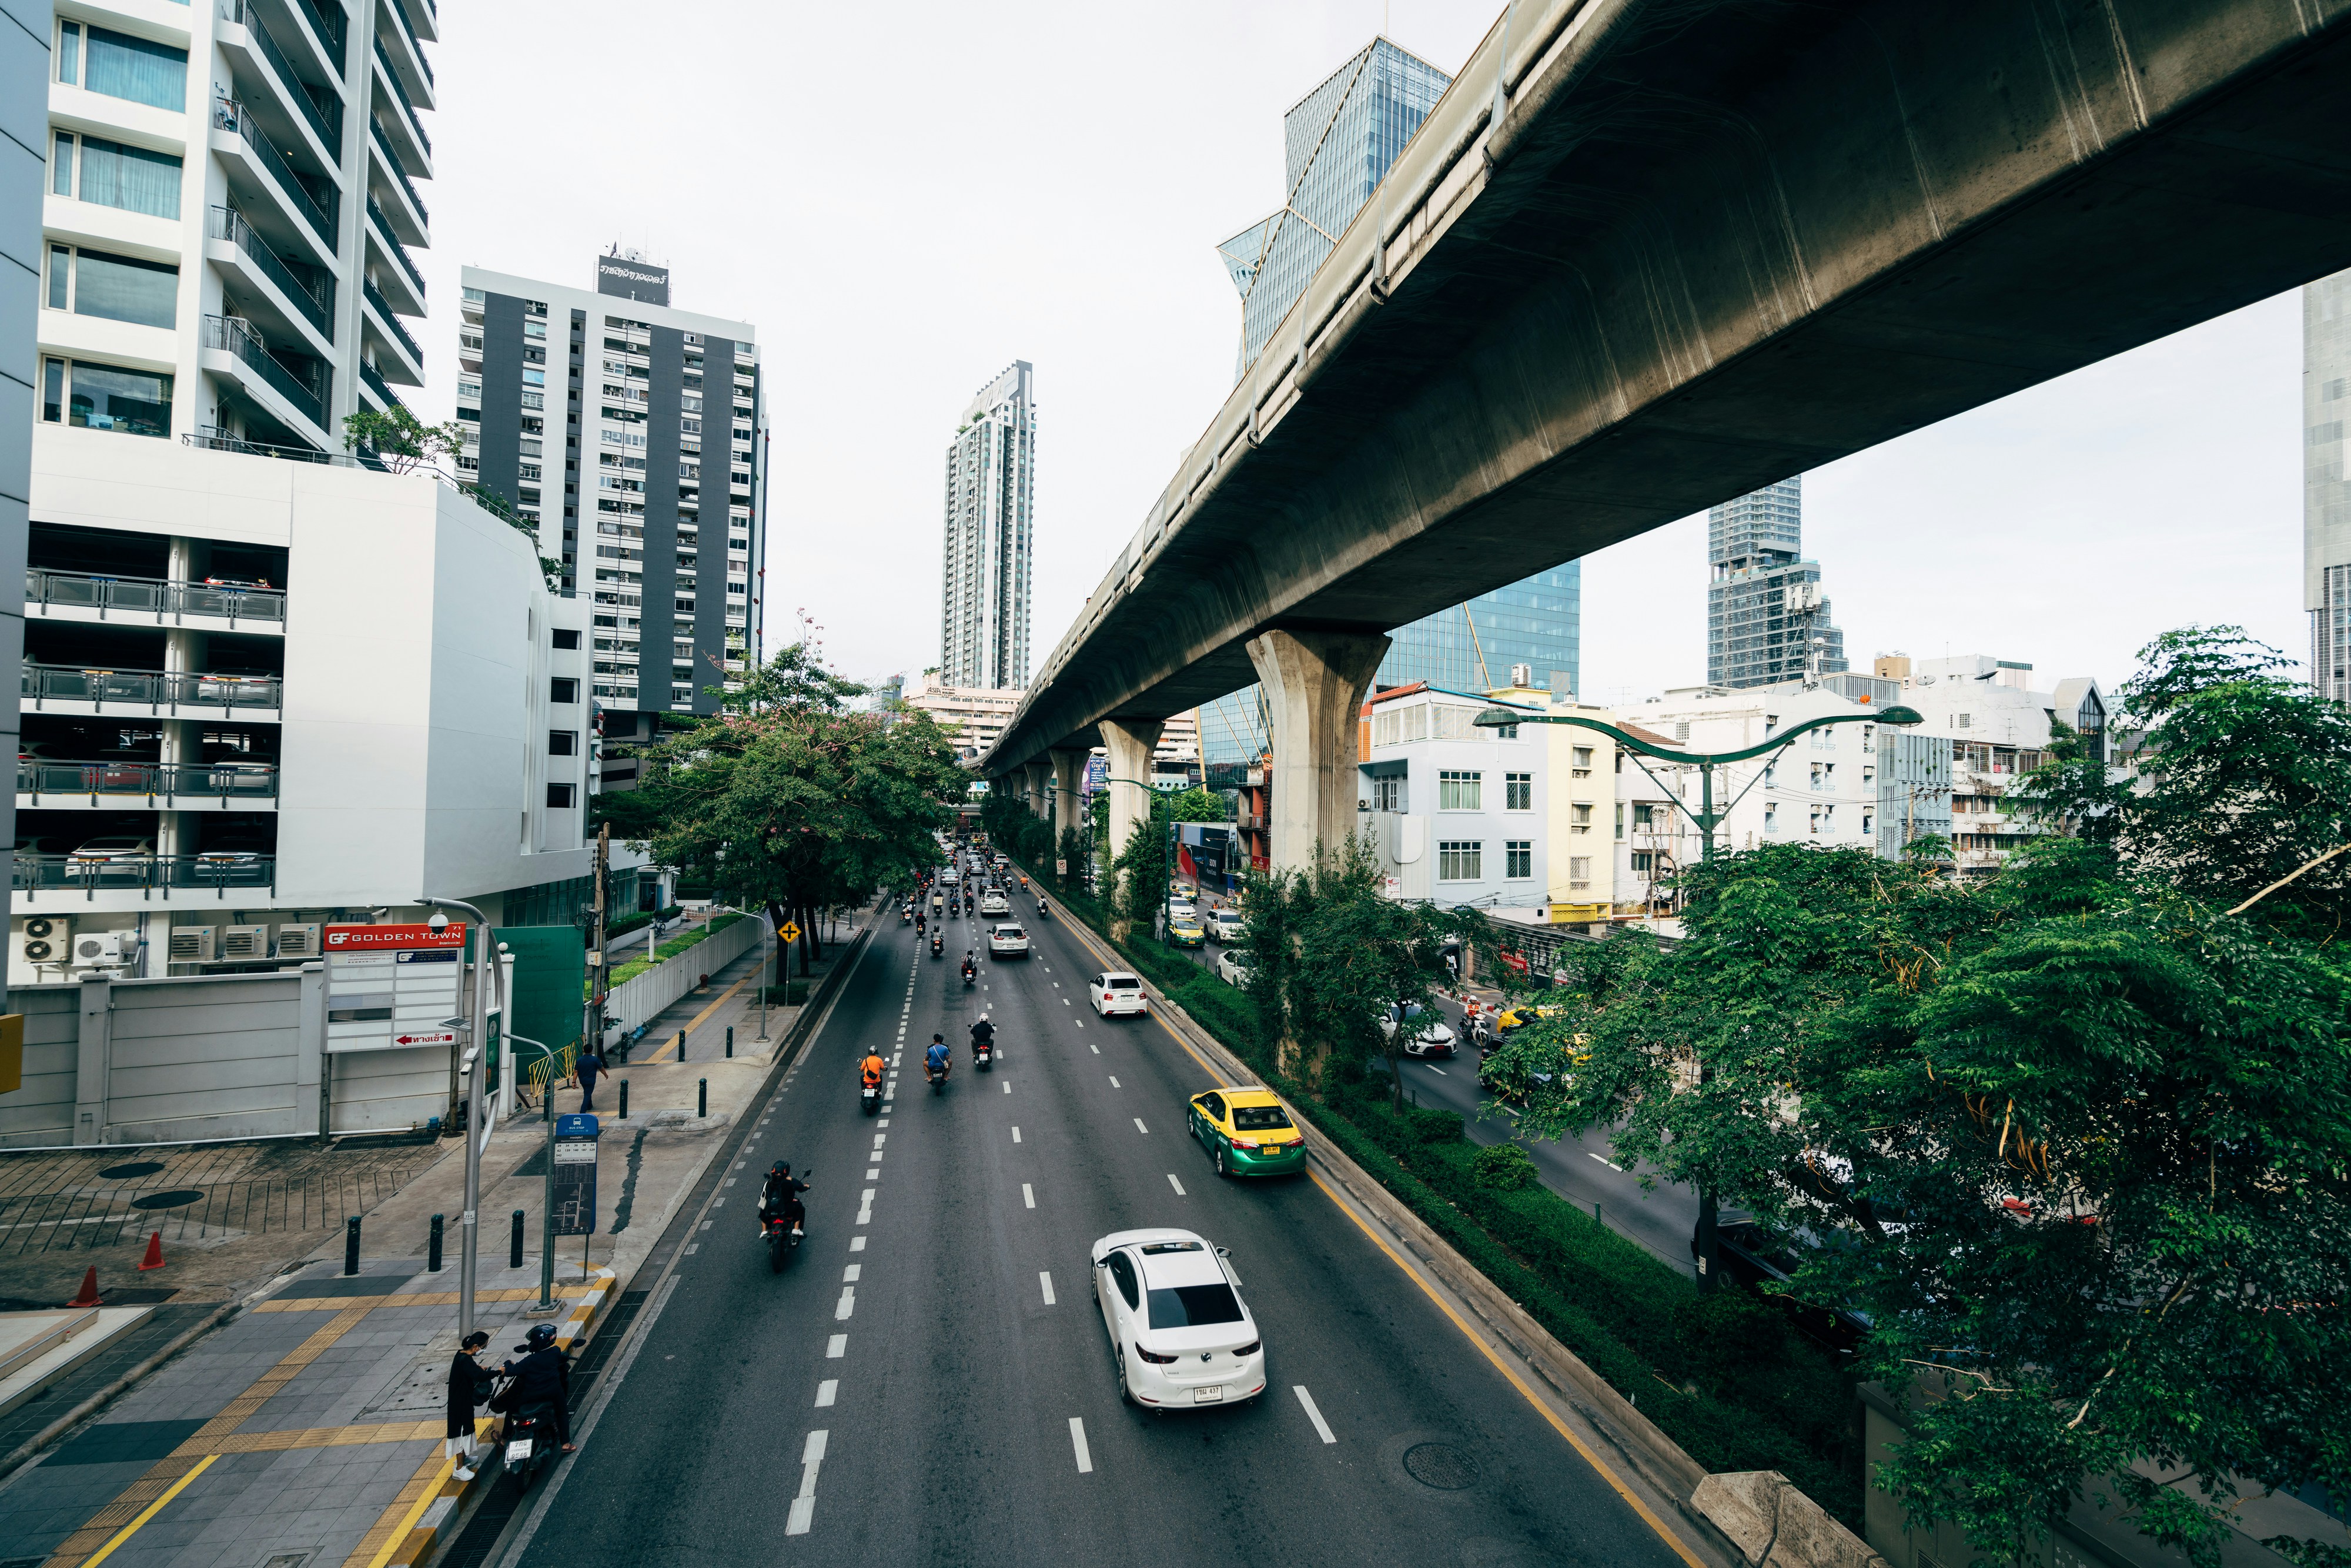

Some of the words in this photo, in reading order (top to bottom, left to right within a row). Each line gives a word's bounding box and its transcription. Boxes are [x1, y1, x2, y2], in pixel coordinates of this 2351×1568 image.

[352, 933, 414, 941] GOLDEN
[413, 1033, 445, 1043] ทางเข้า
